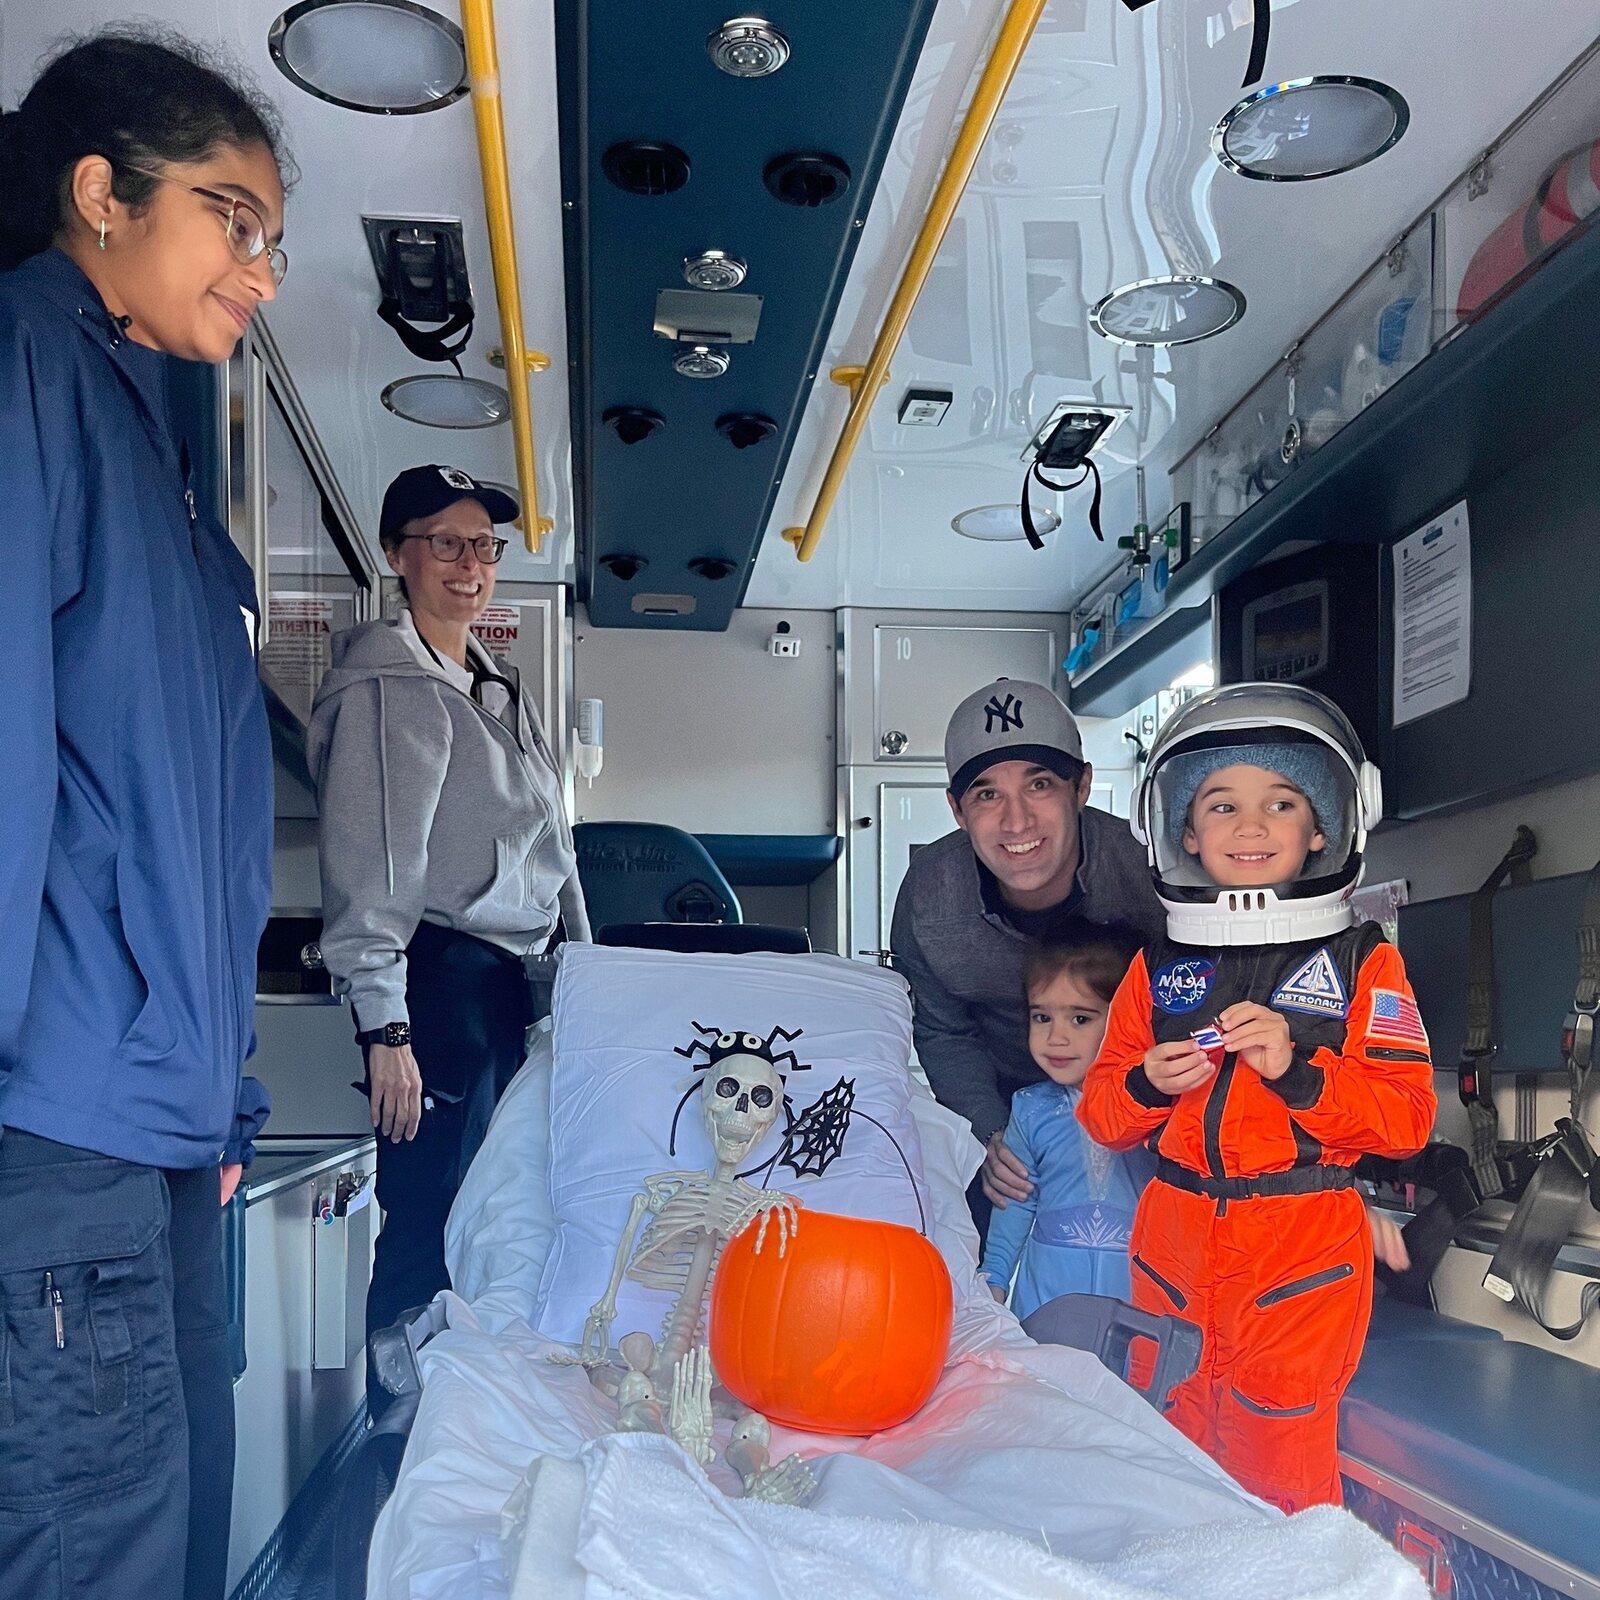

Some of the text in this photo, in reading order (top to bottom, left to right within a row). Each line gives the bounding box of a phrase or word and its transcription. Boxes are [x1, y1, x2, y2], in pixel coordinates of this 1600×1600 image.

[896, 637, 912, 660] 10
[984, 693, 1024, 733] NY
[900, 797, 911, 820] 11
[1158, 974, 1207, 989] NASA
[1277, 993, 1345, 1010] ASTRONAUT
